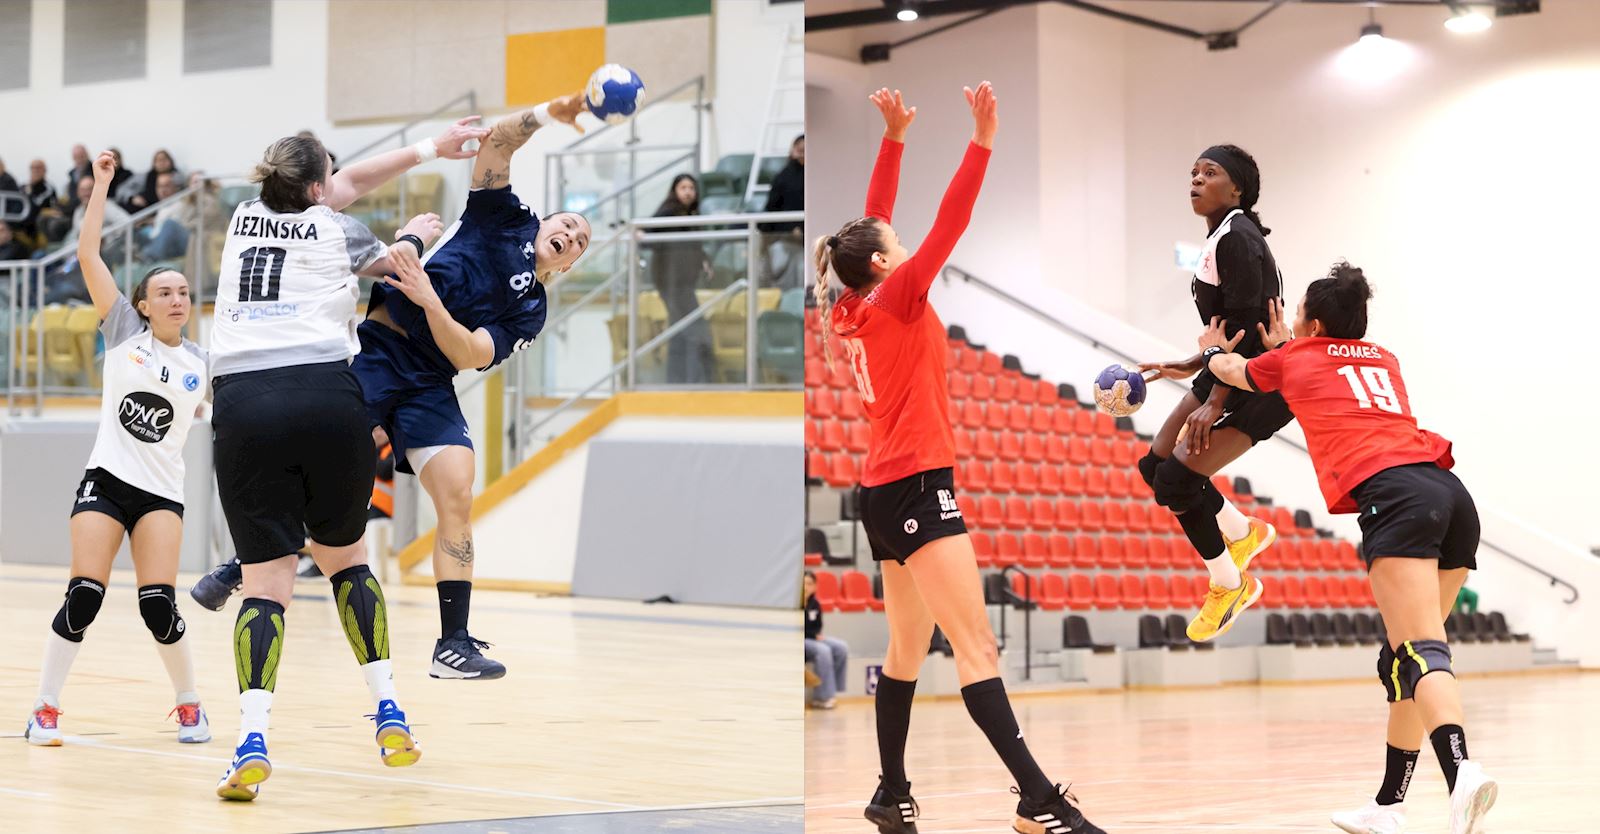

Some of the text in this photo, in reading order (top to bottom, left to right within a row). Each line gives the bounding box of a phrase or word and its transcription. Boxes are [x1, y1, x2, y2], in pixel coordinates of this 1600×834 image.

[233, 215, 318, 240] LEZINSKA
[239, 246, 287, 302] 10
[1327, 343, 1382, 359] GOMES
[160, 366, 169, 383] 9
[1336, 364, 1403, 415] 19
[1394, 761, 1414, 800] Kempa
